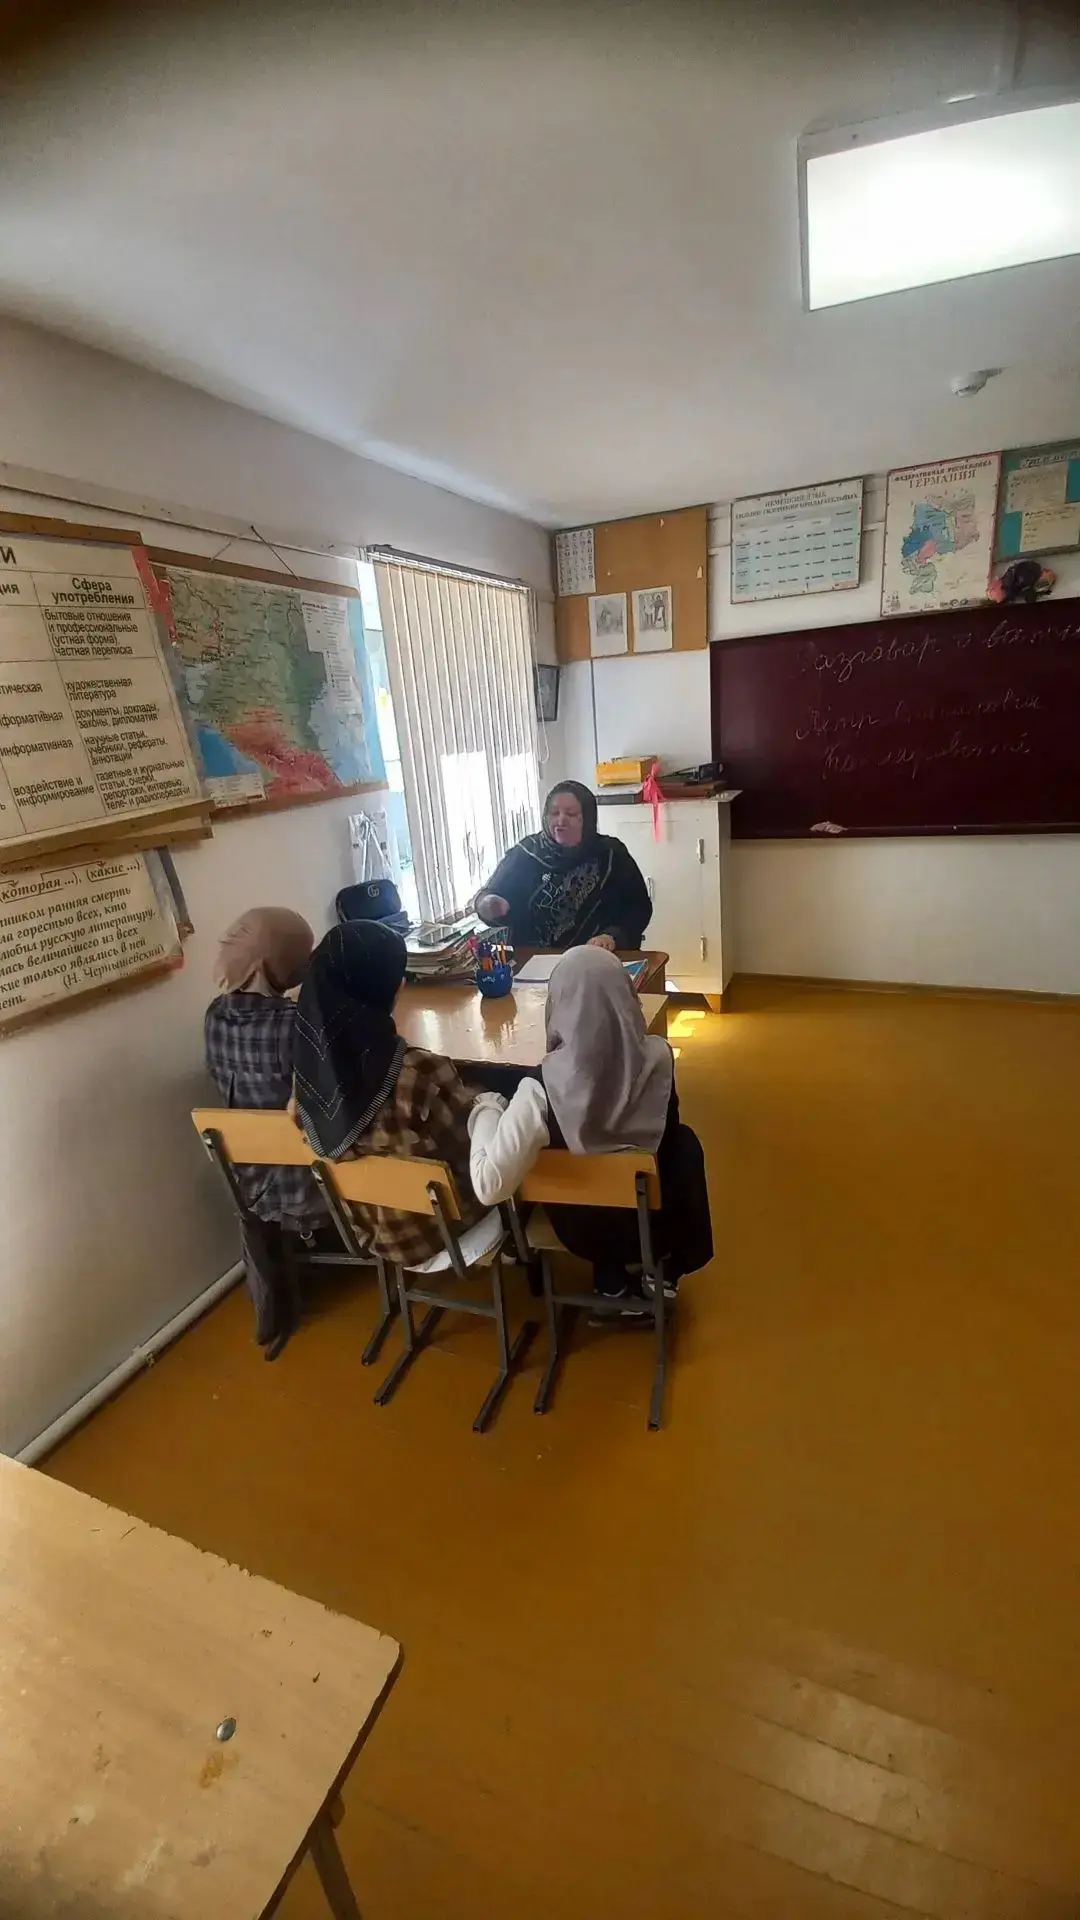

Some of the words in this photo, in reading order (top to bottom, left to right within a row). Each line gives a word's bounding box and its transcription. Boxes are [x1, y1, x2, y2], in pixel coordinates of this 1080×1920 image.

[909, 470, 976, 488] ГЕРМАНИЯ
[72, 577, 112, 592] Сфера
[52, 592, 135, 605] употребления
[44, 609, 85, 621] бытовые
[87, 612, 132, 621] отношения
[48, 624, 55, 632] и
[57, 622, 139, 633] профессиональные
[51, 634, 86, 648] (устная
[55, 645, 90, 657] частная
[92, 646, 133, 656] переписка
[0, 683, 43, 694] тическая
[65, 678, 133, 691] художественная
[69, 689, 117, 701] литература
[84, 733, 119, 747] научные
[91, 752, 133, 766] аннотации
[96, 768, 132, 781] газетные
[139, 760, 185, 773] журнальные
[13, 778, 74, 796] воздействие
[76, 777, 83, 785] и
[17, 785, 94, 807] информирование
[48, 897, 88, 918] ранняя
[91, 887, 132, 903] смерть
[17, 915, 74, 940] горестью
[104, 902, 127, 914] кто
[27, 939, 99, 967] величайшего
[102, 935, 115, 945] из
[117, 927, 139, 941] всех
[40, 928, 86, 951] русскую
[23, 963, 67, 985] только
[70, 947, 119, 970] являлись
[121, 942, 127, 953] в
[129, 937, 147, 950] ней
[83, 943, 165, 978] Чернышевский)
